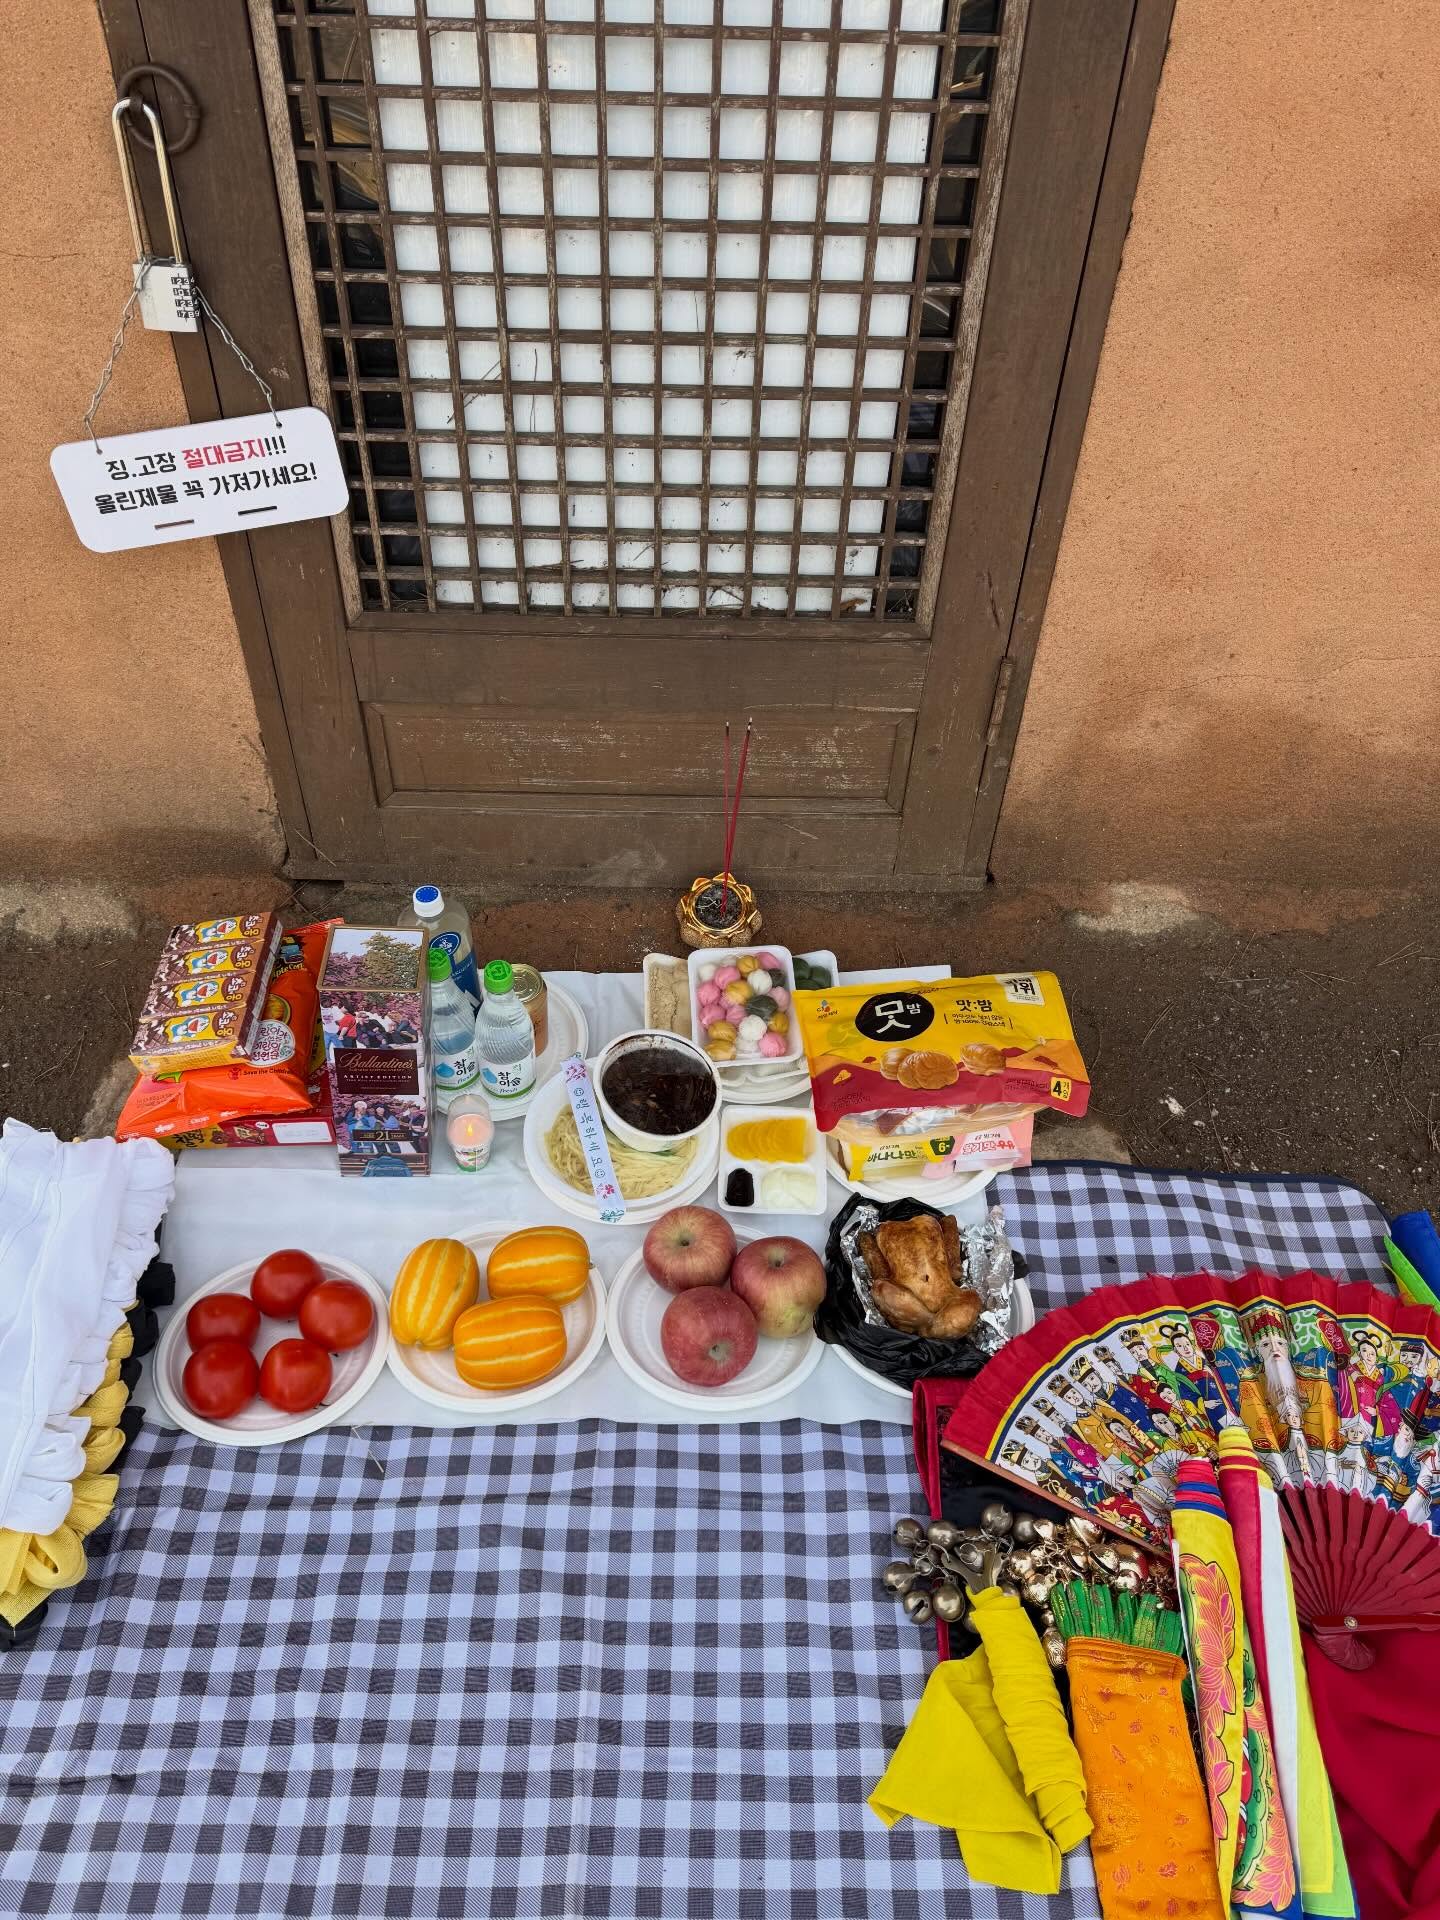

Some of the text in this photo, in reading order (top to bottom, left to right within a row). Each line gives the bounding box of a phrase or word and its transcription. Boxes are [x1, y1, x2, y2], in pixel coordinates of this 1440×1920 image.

[105, 436, 287, 481] 징.고장 절대금지!!!
[95, 462, 318, 515] 올린제물 꼭 가져가세요!
[375, 1131, 391, 1141] 21
